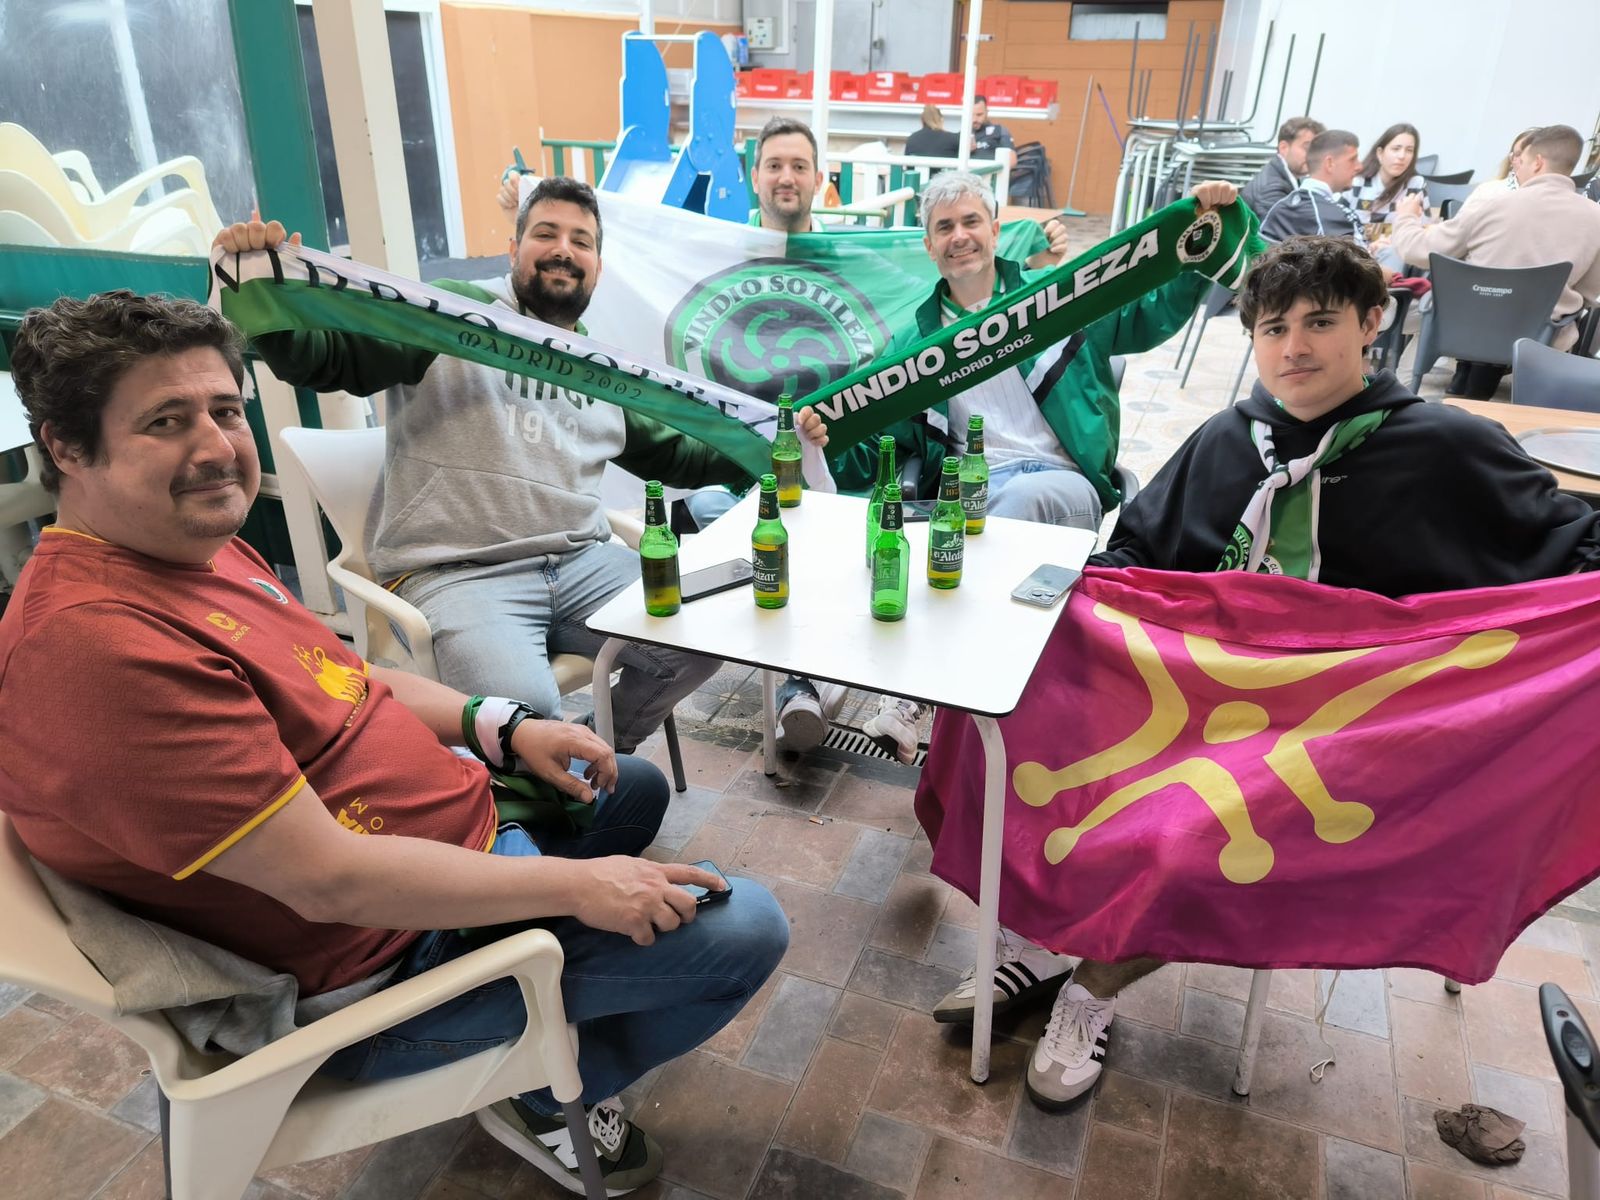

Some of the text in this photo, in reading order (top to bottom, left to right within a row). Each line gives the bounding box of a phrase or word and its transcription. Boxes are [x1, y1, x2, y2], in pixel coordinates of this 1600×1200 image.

[684, 275, 875, 367] VINDIO SOTILEZA
[1472, 284, 1513, 294] Cruzcampo
[814, 228, 1160, 421] VINDIO SOTILEZA
[457, 331, 574, 376] MADRID
[583, 369, 642, 400] 2002
[938, 334, 1034, 387] MADRID 2002
